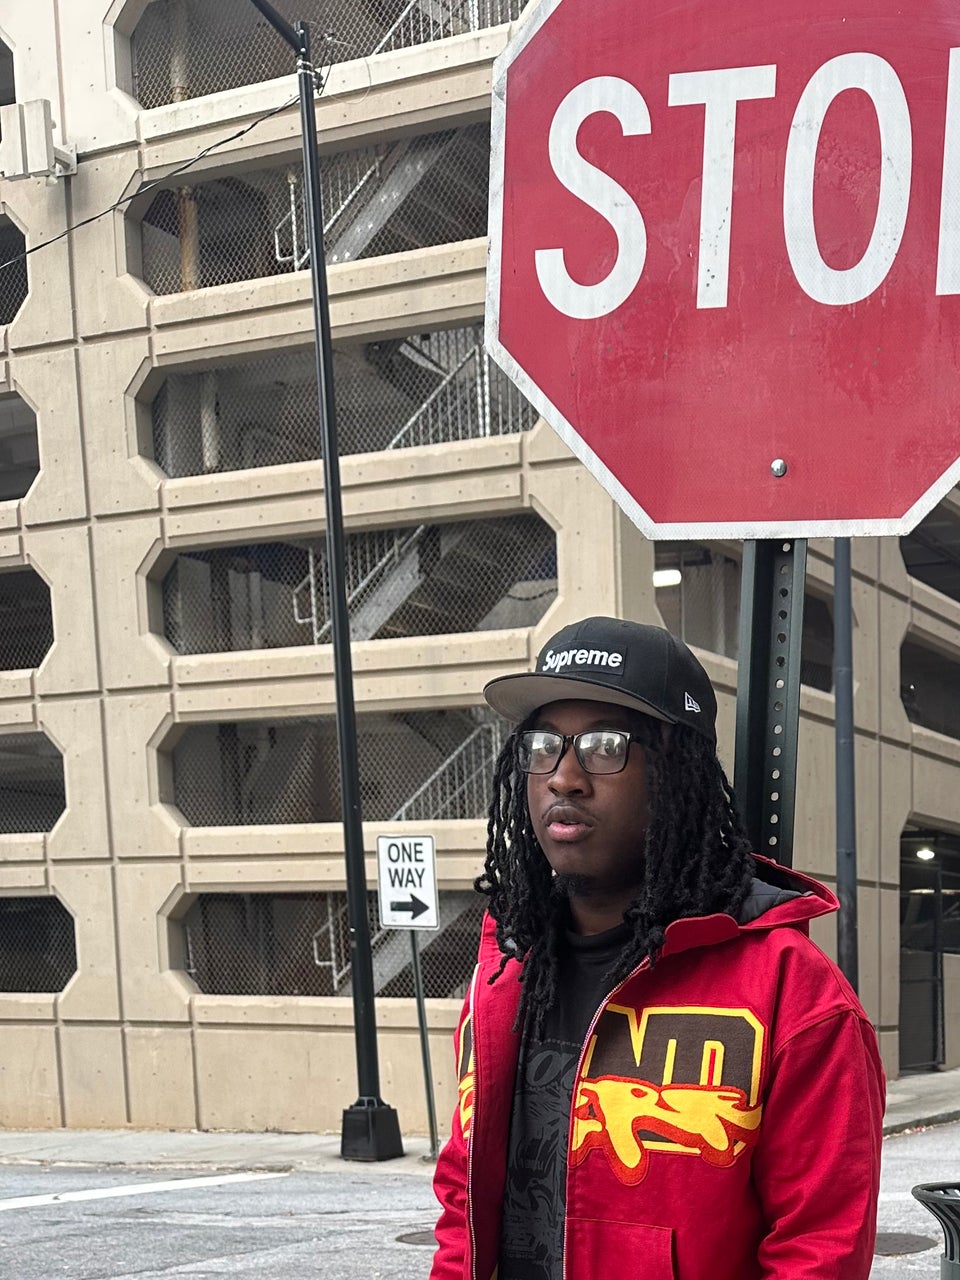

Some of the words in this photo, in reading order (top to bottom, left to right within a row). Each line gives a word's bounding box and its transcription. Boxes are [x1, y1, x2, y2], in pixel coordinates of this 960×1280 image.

[542, 648, 623, 672] Supreme
[387, 843, 424, 863] ONE
[387, 867, 426, 888] WAY
